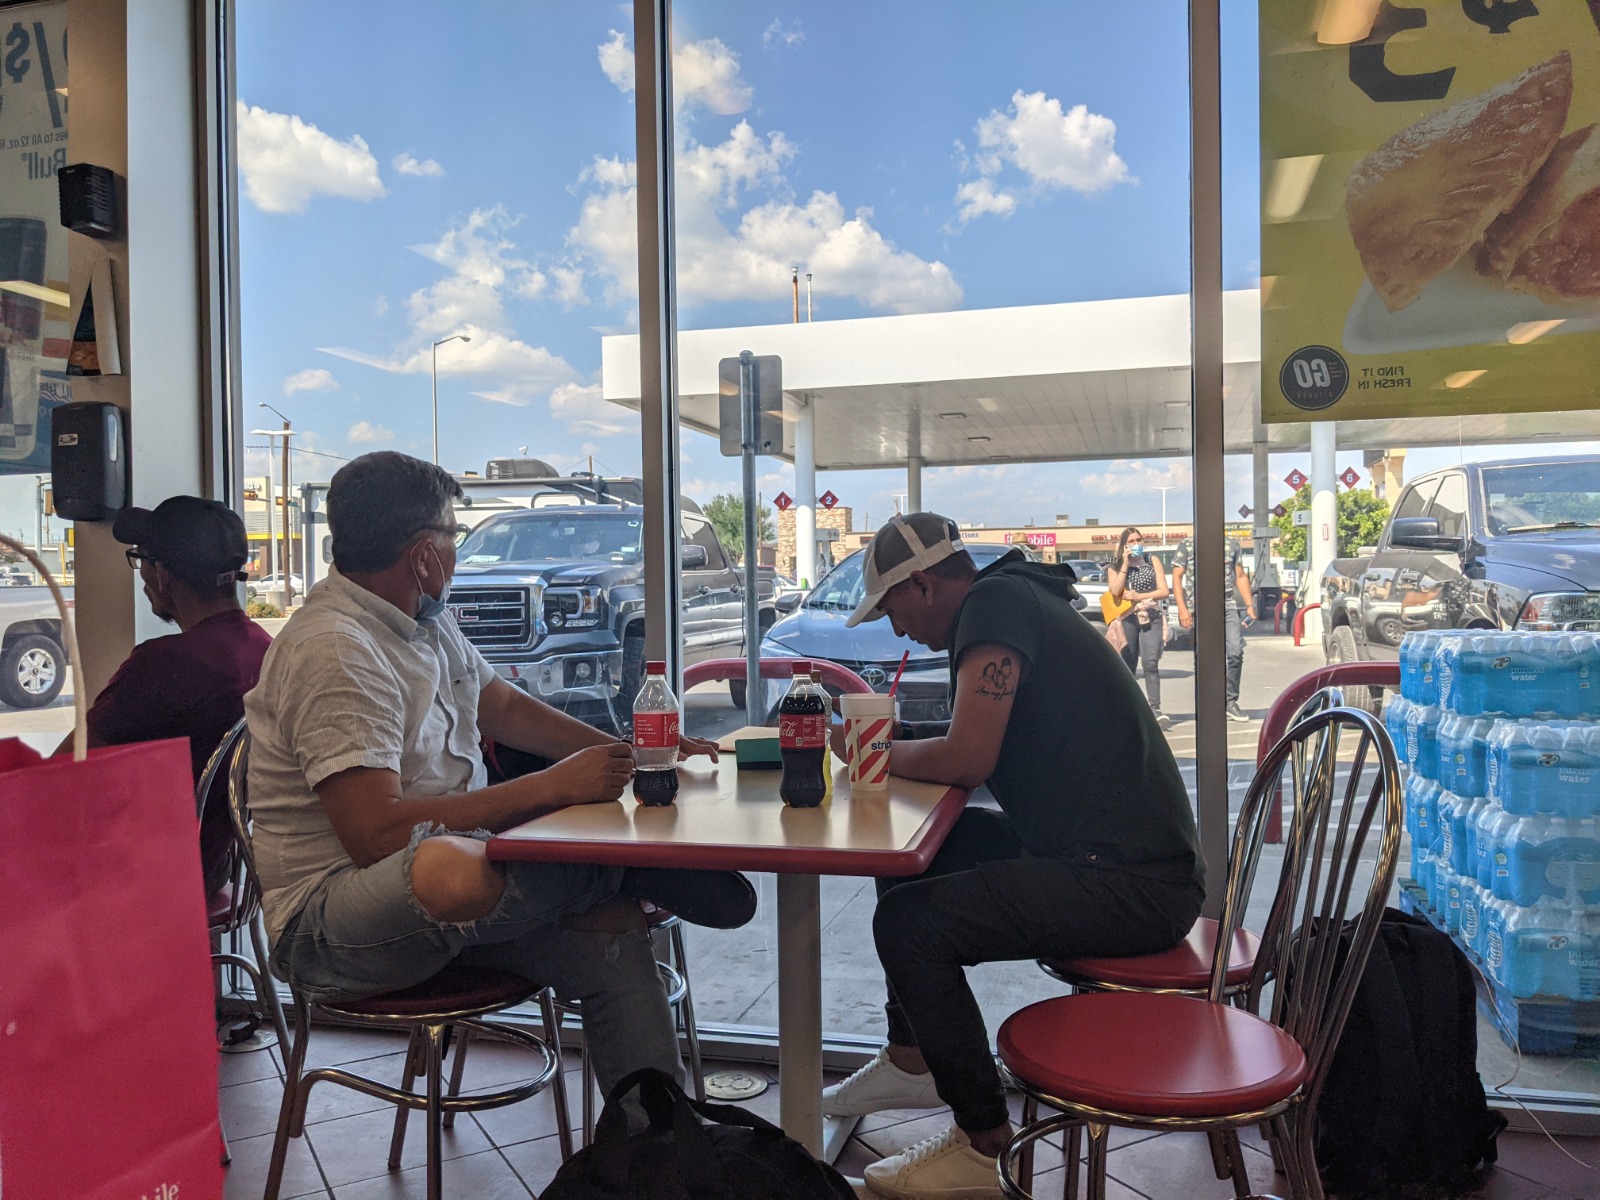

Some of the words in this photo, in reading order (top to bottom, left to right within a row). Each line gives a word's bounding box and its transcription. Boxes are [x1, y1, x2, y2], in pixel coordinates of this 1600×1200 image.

[1292, 475, 1300, 484] 5
[1346, 473, 1353, 483] 6
[781, 497, 785, 506] 1
[825, 496, 832, 505] 2
[1297, 513, 1302, 522] 5
[1559, 775, 1590, 783] water
